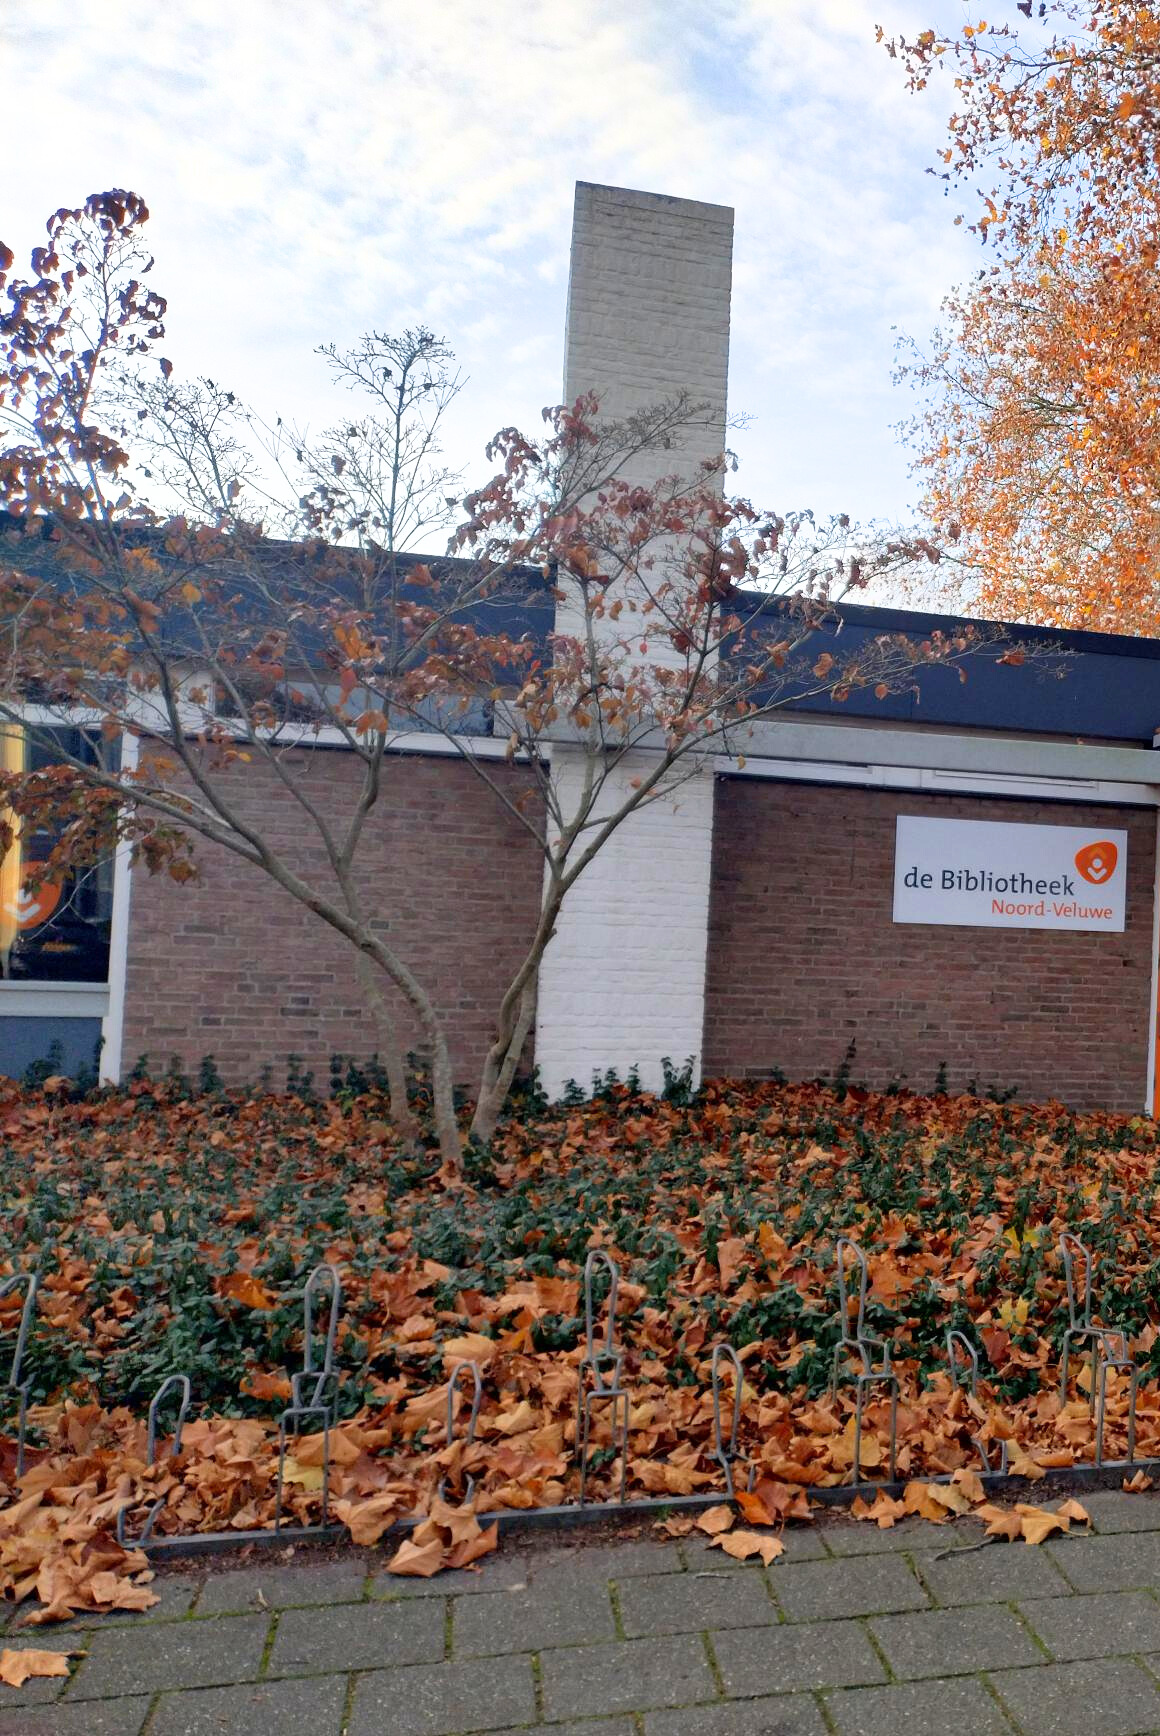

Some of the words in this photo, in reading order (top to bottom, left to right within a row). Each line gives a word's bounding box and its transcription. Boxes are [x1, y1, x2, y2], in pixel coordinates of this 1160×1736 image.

[903, 867, 933, 889] de
[941, 869, 1075, 896] Bibliotheek
[991, 899, 1113, 920] Noord-Veluwe
